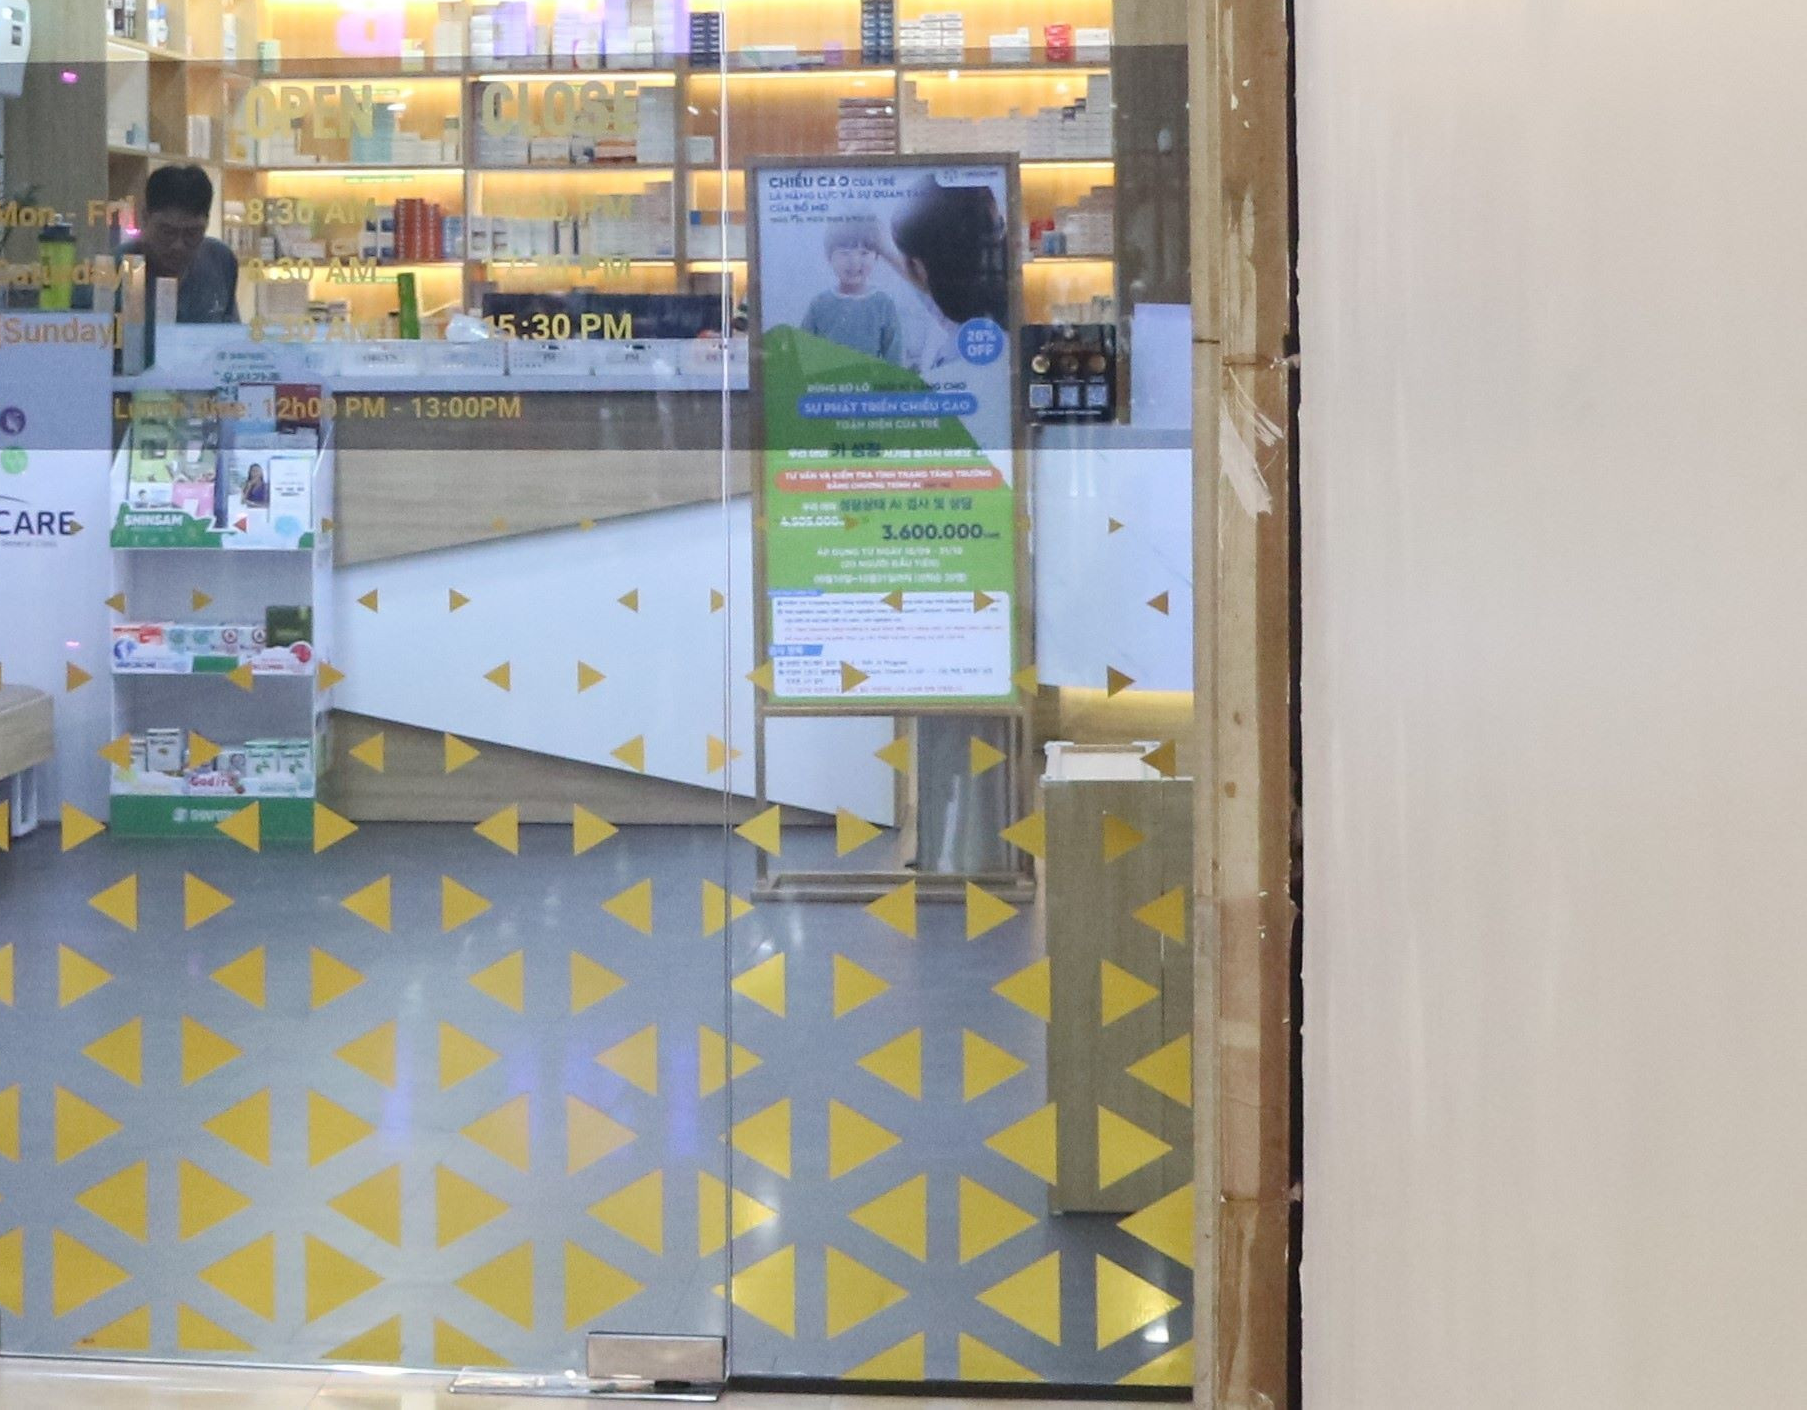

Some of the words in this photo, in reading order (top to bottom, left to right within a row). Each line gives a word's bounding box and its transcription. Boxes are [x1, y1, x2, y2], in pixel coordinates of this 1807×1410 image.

[246, 84, 374, 140] OPEN
[481, 80, 639, 138] CLOSE
[817, 176, 849, 188] CAO
[247, 197, 315, 225] 8:30
[325, 256, 378, 282] AM
[483, 312, 572, 340] 15:30
[580, 311, 633, 340] PM
[967, 344, 994, 357] OFF
[263, 396, 337, 420] 12h00
[345, 396, 385, 419] PM
[411, 396, 522, 420] 13:00PM
[942, 401, 970, 412] CAO
[124, 514, 184, 527] SHINSAM
[882, 524, 983, 540] 3.600.000
